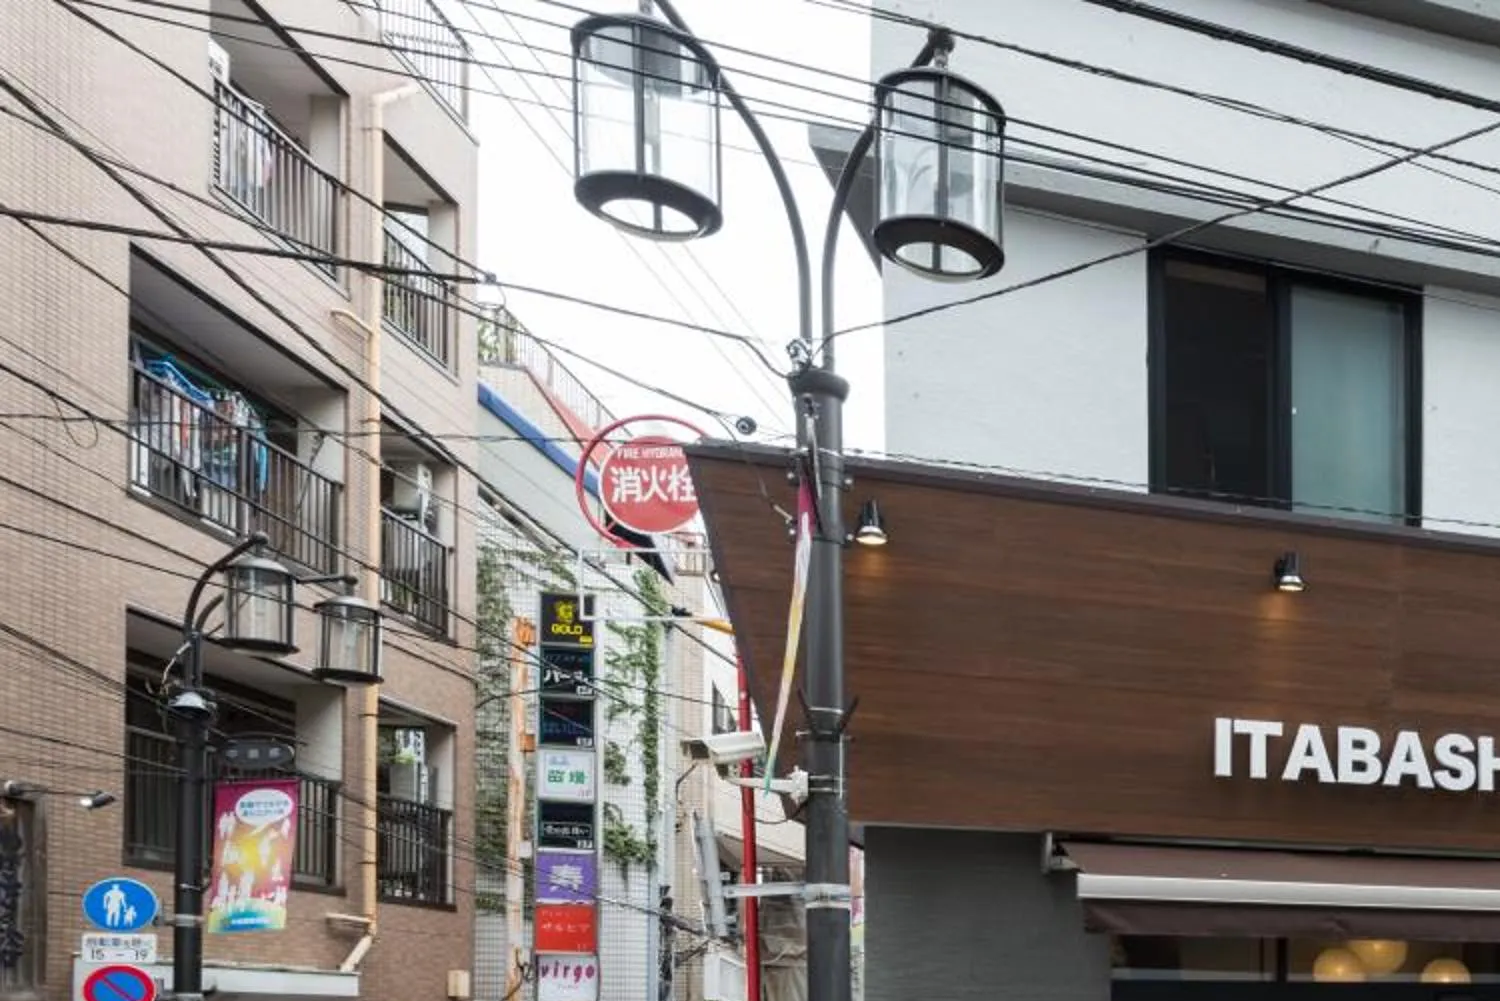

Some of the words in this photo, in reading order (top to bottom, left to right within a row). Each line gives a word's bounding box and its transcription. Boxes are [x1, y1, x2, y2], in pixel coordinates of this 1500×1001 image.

[643, 448, 684, 459] HYDRAN
[610, 465, 698, 502] 消火栓
[551, 624, 583, 634] GOLD
[91, 948, 105, 960] 15
[135, 948, 148, 960] 19
[541, 961, 595, 983] virgo
